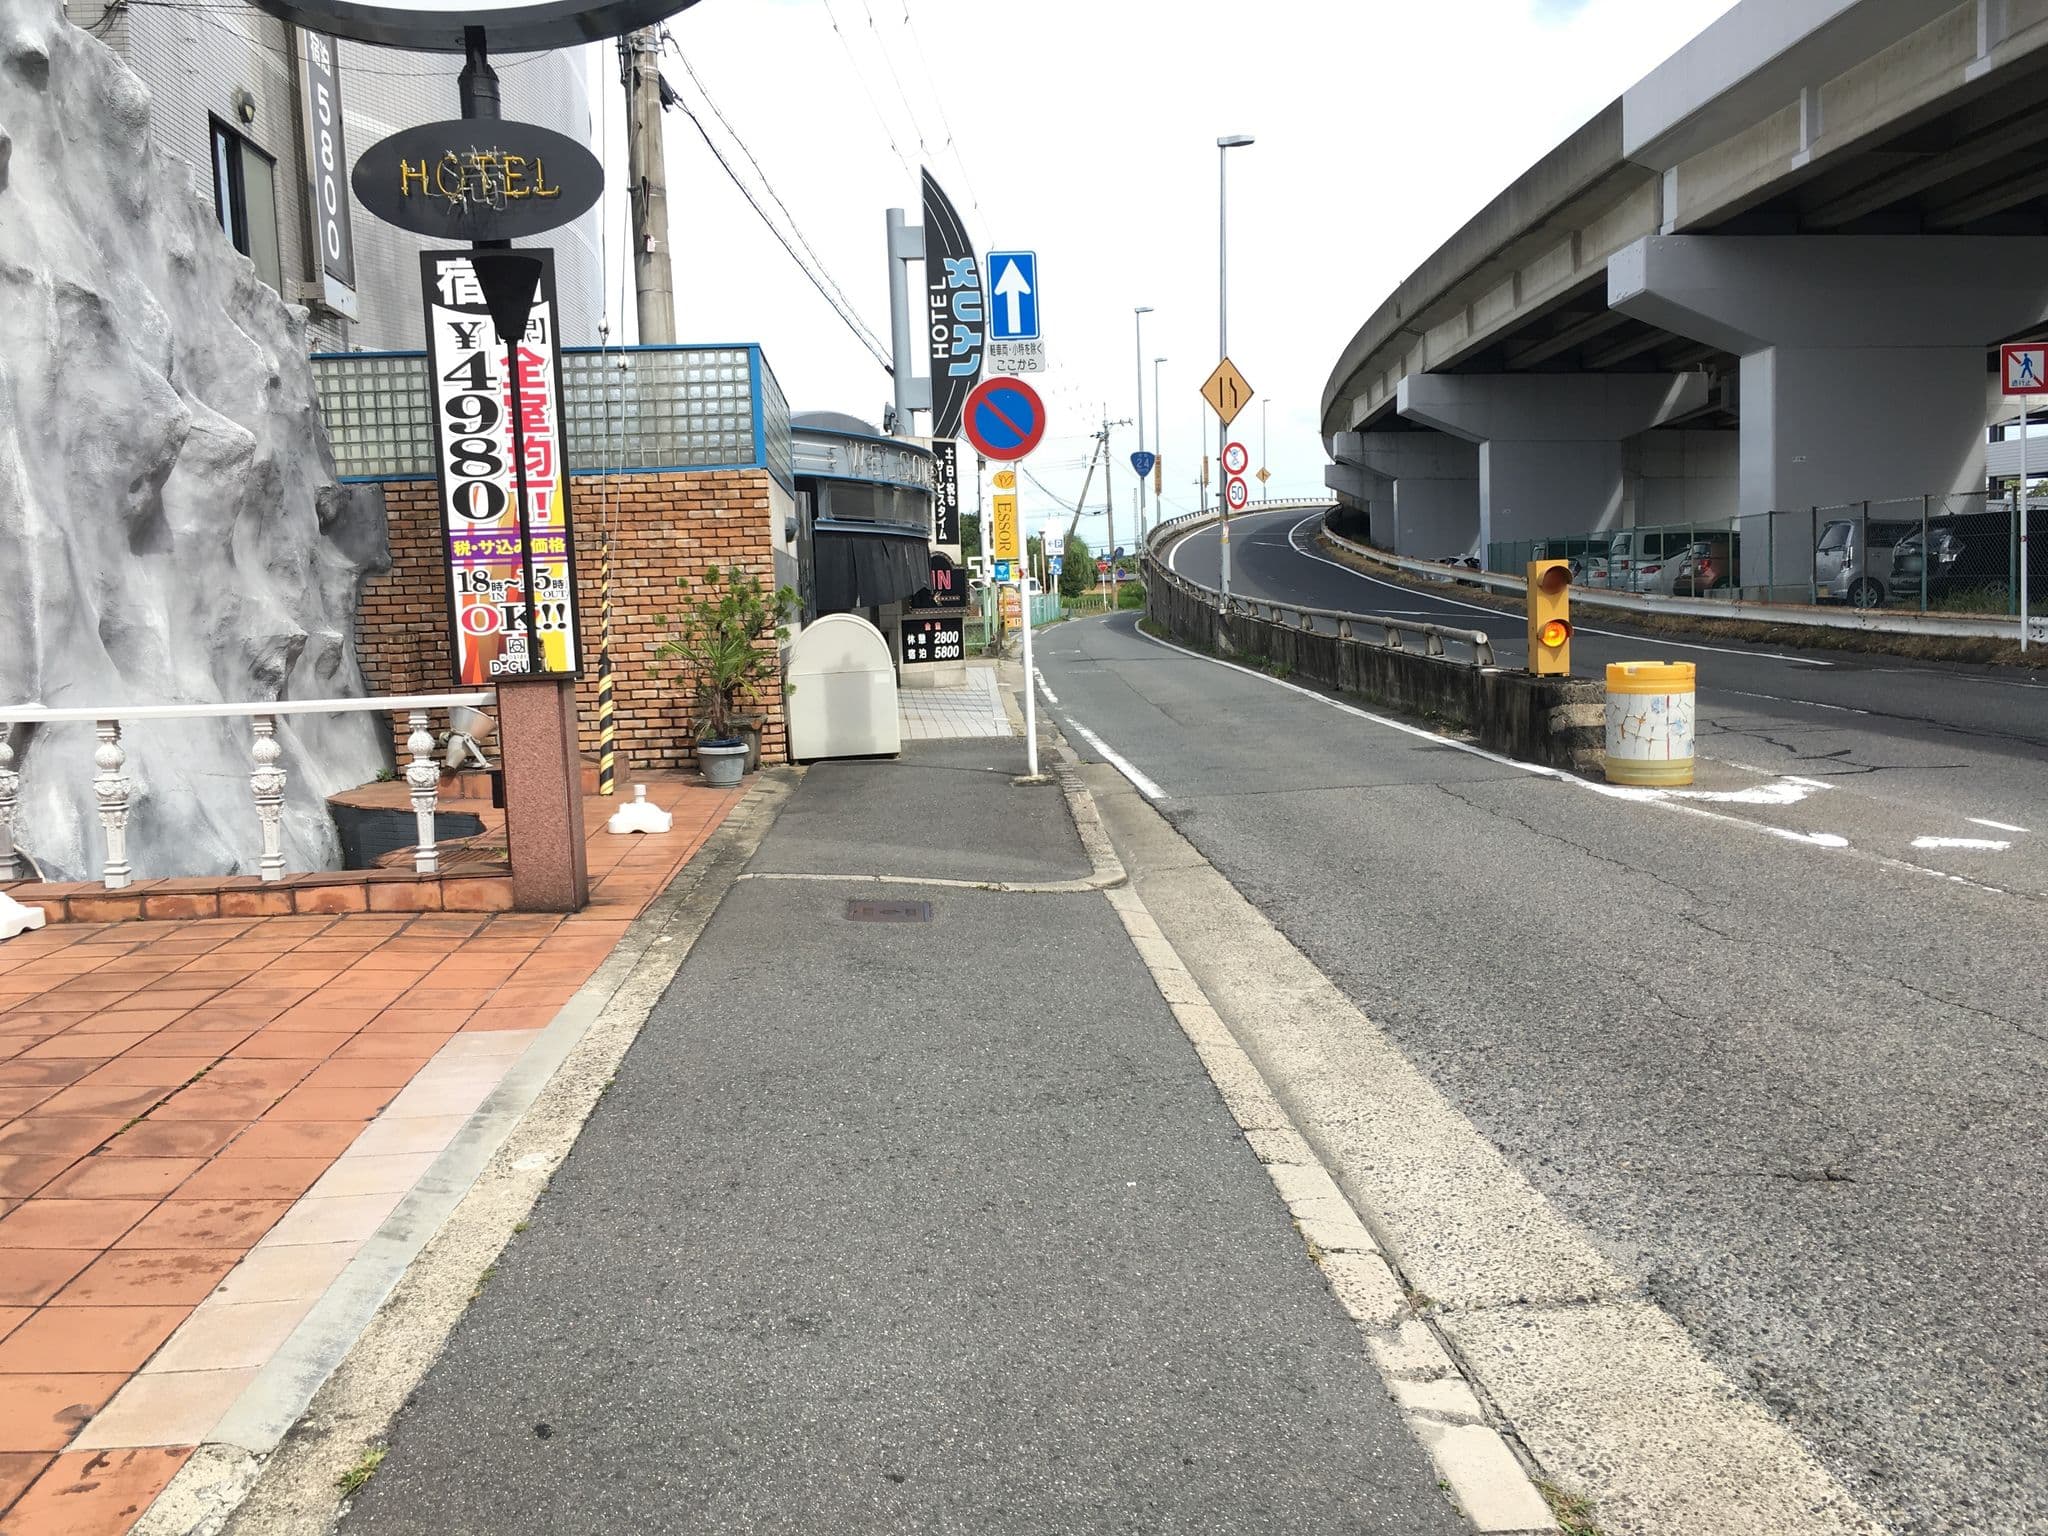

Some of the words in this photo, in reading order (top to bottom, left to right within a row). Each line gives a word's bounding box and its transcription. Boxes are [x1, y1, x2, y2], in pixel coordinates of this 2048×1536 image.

[317, 82, 341, 261] 5800
[400, 152, 562, 202] HOTEL
[930, 276, 950, 359] HOTEL
[996, 358, 1038, 371] ここから
[934, 459, 948, 540] サービスタイム
[1231, 486, 1244, 500] 50
[996, 502, 1012, 552] ESSOR
[491, 592, 505, 601] IN
[543, 590, 566, 599] OUT
[461, 603, 567, 635] OK!!
[934, 630, 960, 645] 2800
[934, 645, 961, 659] 5800
